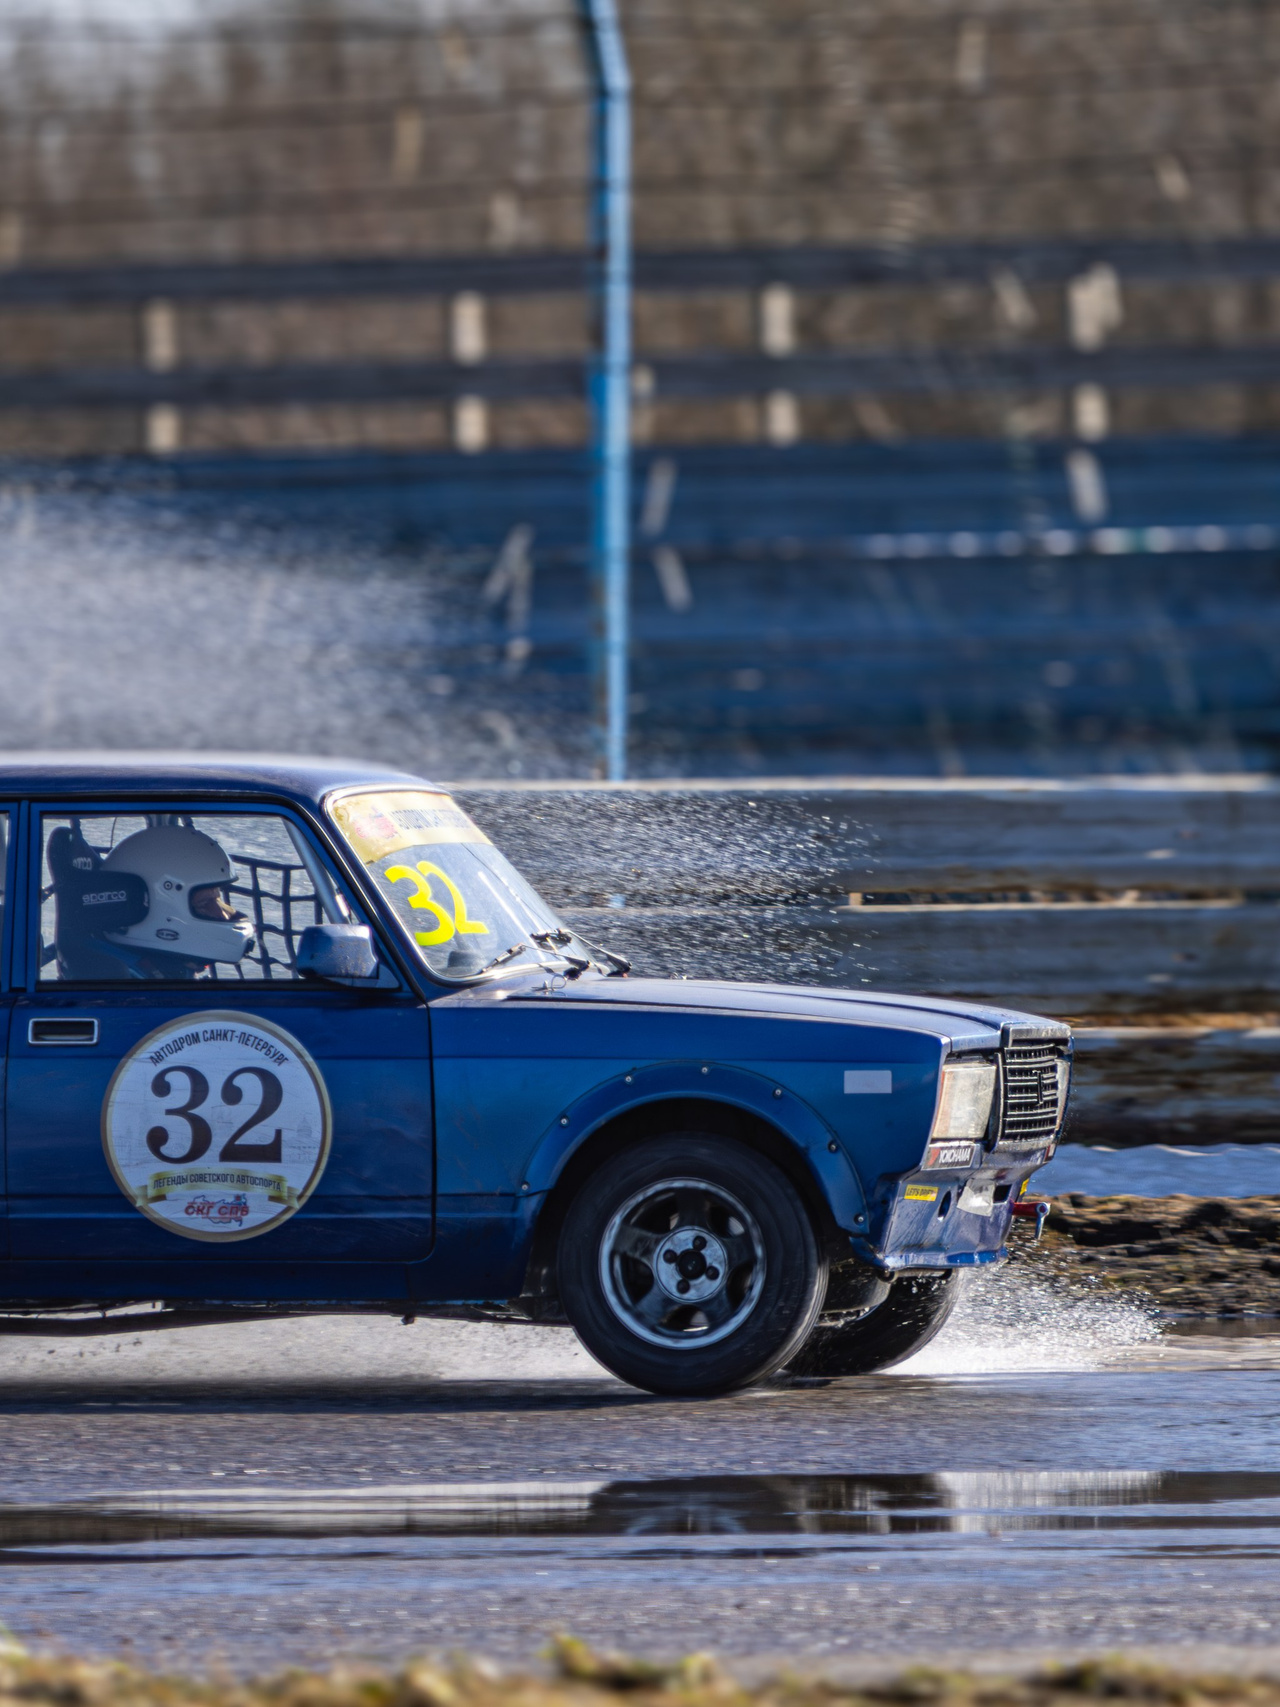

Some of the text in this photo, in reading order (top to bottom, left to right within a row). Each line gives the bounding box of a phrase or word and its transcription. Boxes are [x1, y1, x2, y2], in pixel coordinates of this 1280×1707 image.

[82, 890, 127, 905] sparco
[383, 860, 490, 946] 32
[149, 1029, 289, 1067] АВТОДРОМ САНКТ-ПЕТЕРБУРГ
[146, 1065, 283, 1164] 32
[939, 1147, 971, 1164] YOKOHAMA
[153, 1172, 281, 1192] ЛЕГЕНДЫ СОВЕТСКОГО АВТОСПОРТА
